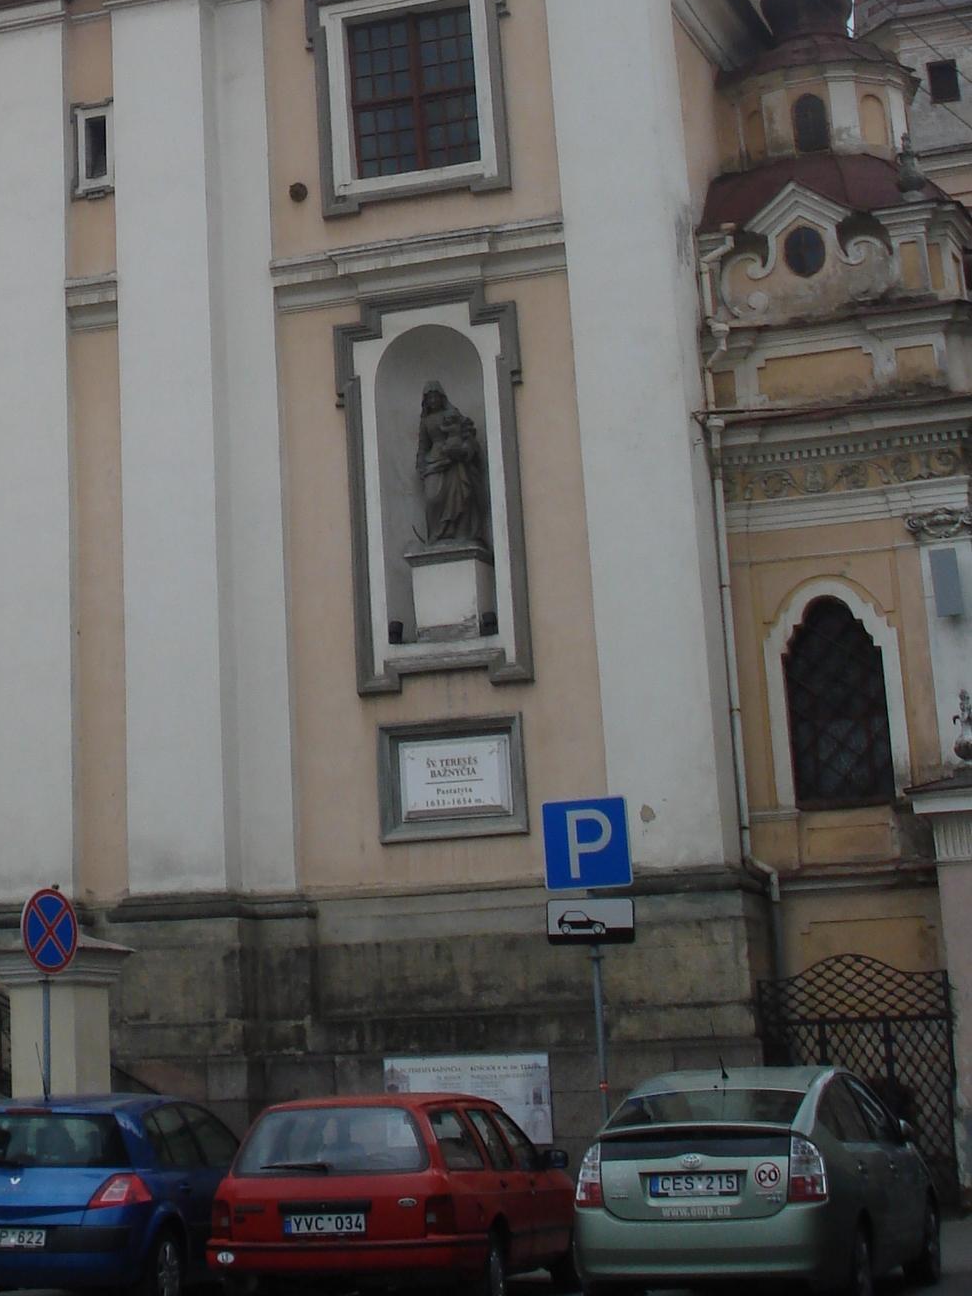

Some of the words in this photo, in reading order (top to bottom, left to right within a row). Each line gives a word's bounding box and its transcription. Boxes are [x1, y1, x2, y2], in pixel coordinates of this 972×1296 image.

[430, 766, 477, 779] BAŽNYČIA
[565, 808, 612, 879] P
[661, 1176, 695, 1192] CES
[706, 1175, 736, 1191] 215
[292, 1215, 324, 1232] YVC
[334, 1215, 364, 1231] 034
[17, 1230, 44, 1245] 622
